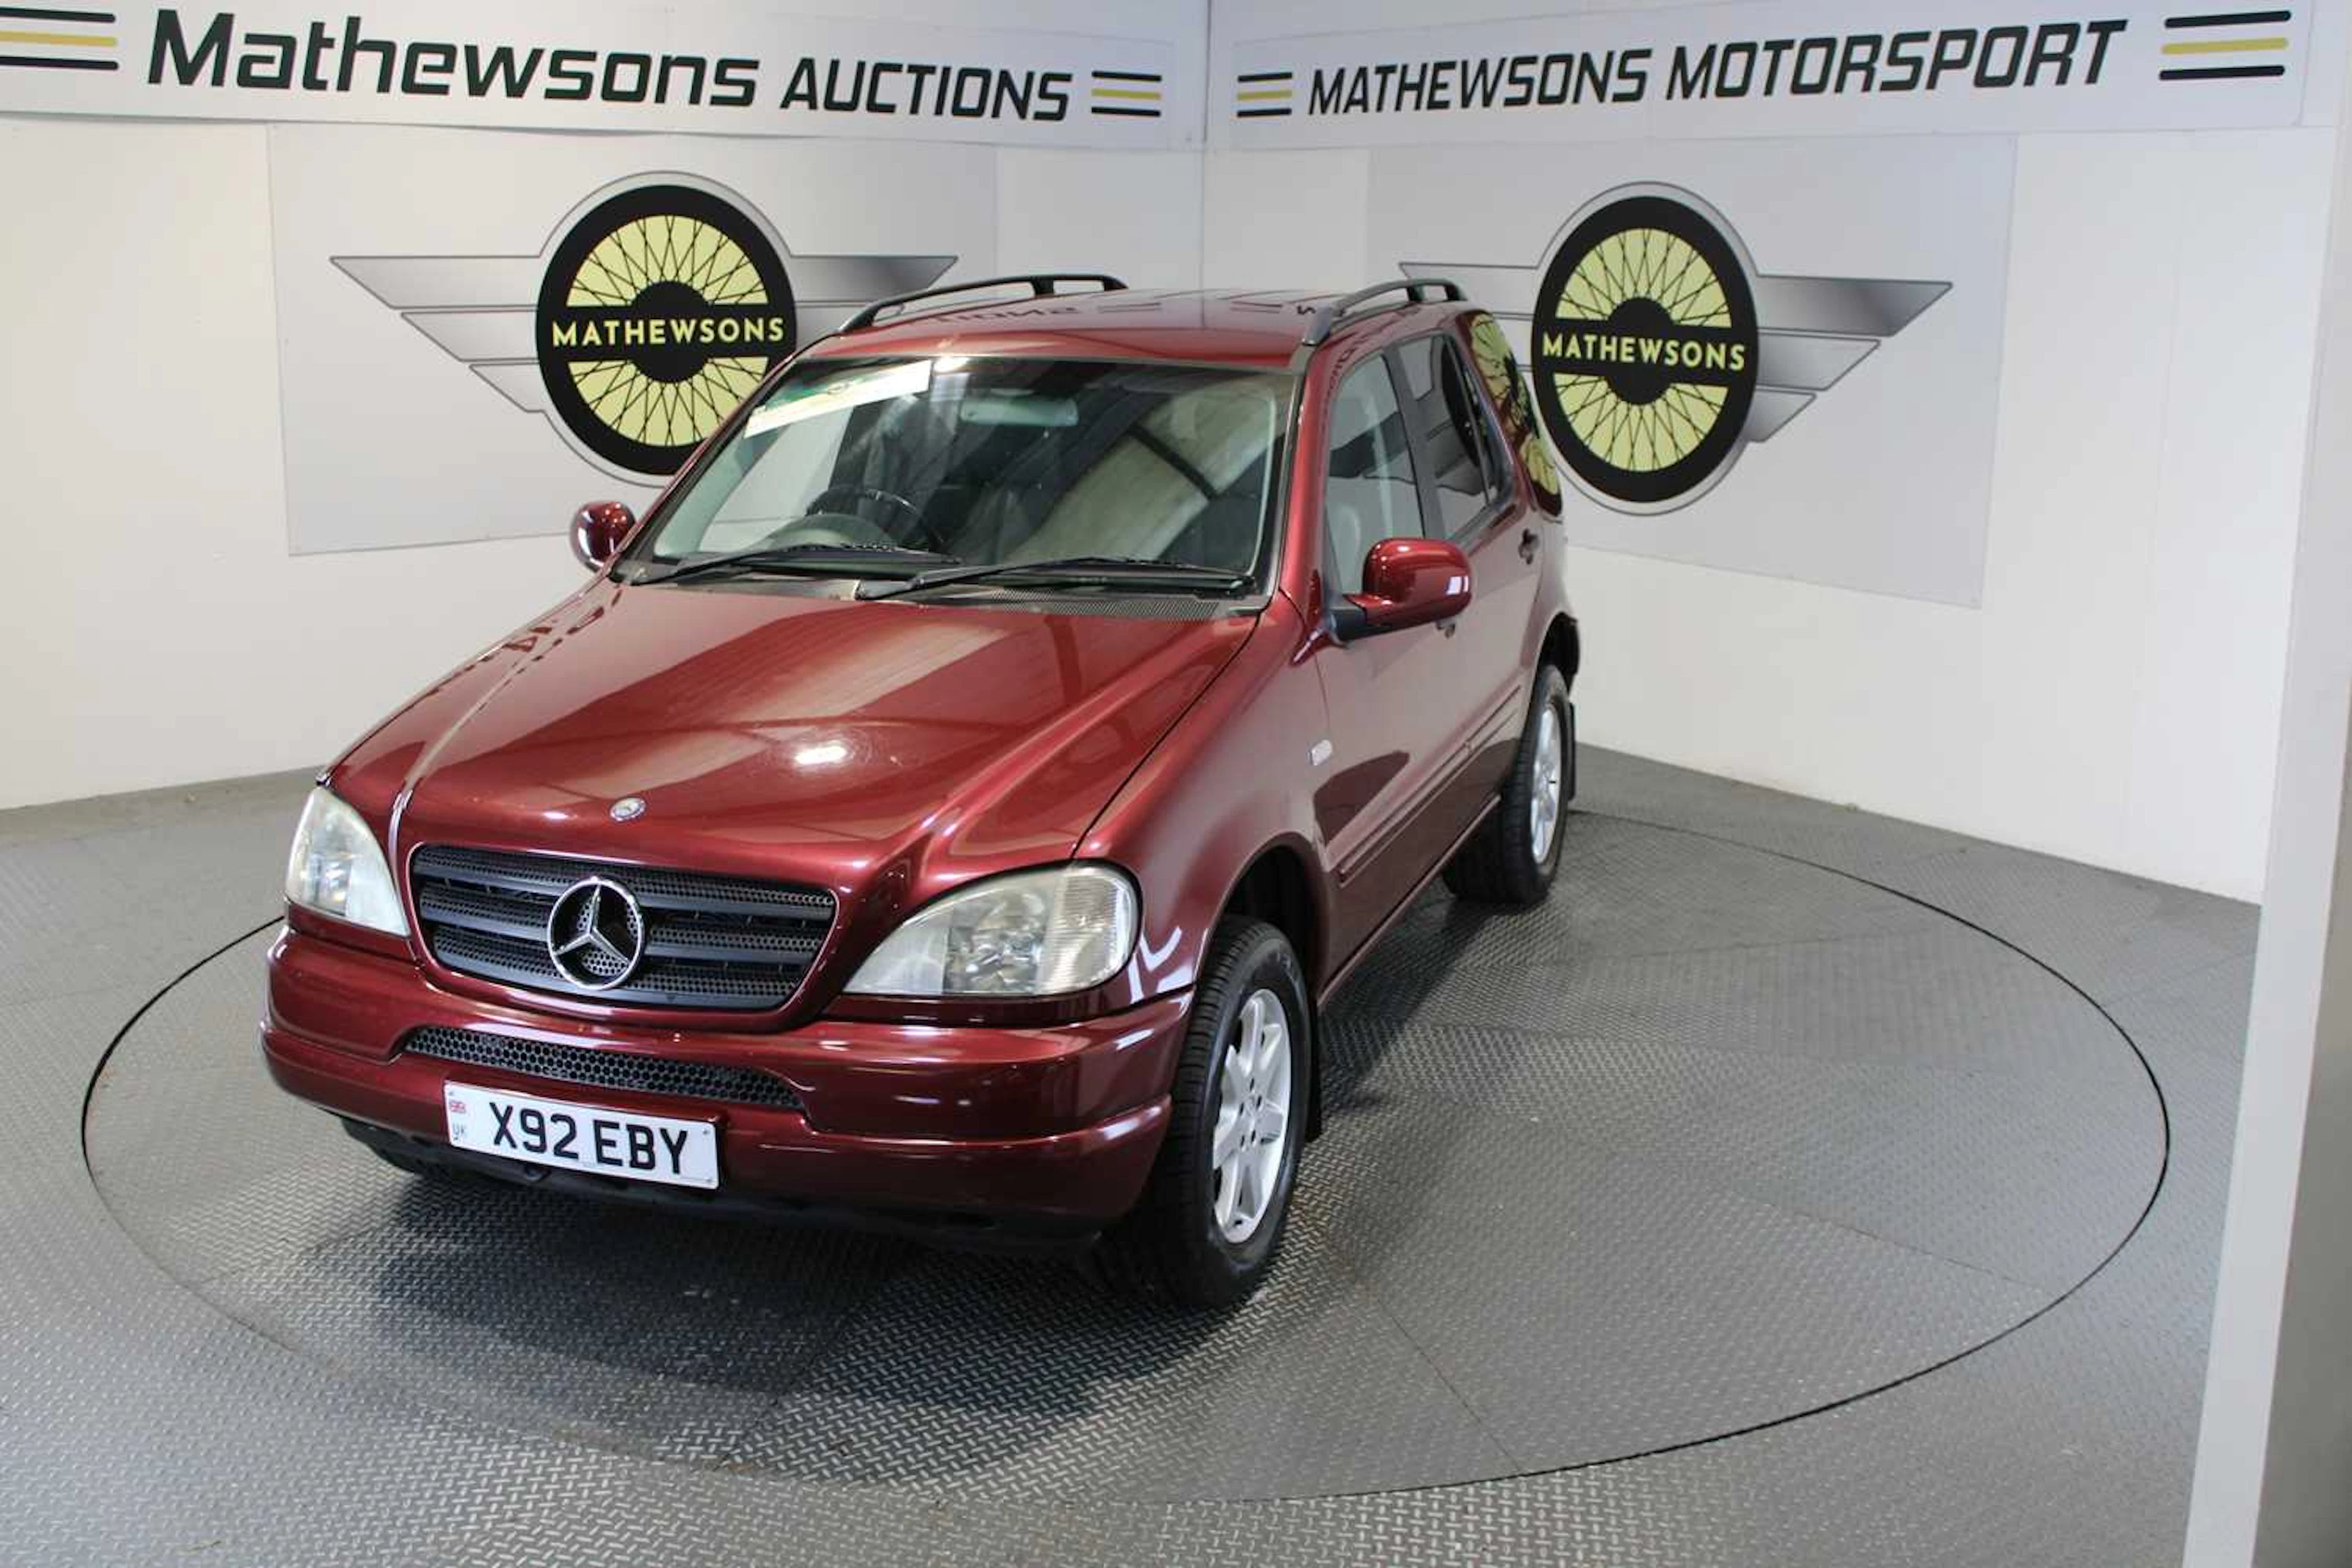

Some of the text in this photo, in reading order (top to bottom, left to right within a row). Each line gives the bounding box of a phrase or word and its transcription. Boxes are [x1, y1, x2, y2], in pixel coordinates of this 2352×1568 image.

[148, 9, 1073, 122] Mathewsons AUCTIONS
[1308, 19, 2128, 116] MATHEWSONS MOTORSPORT
[552, 317, 785, 347] MATHEWSONS
[1542, 331, 1746, 371] MATHEWSONS
[489, 1102, 688, 1175] X92 EBY
